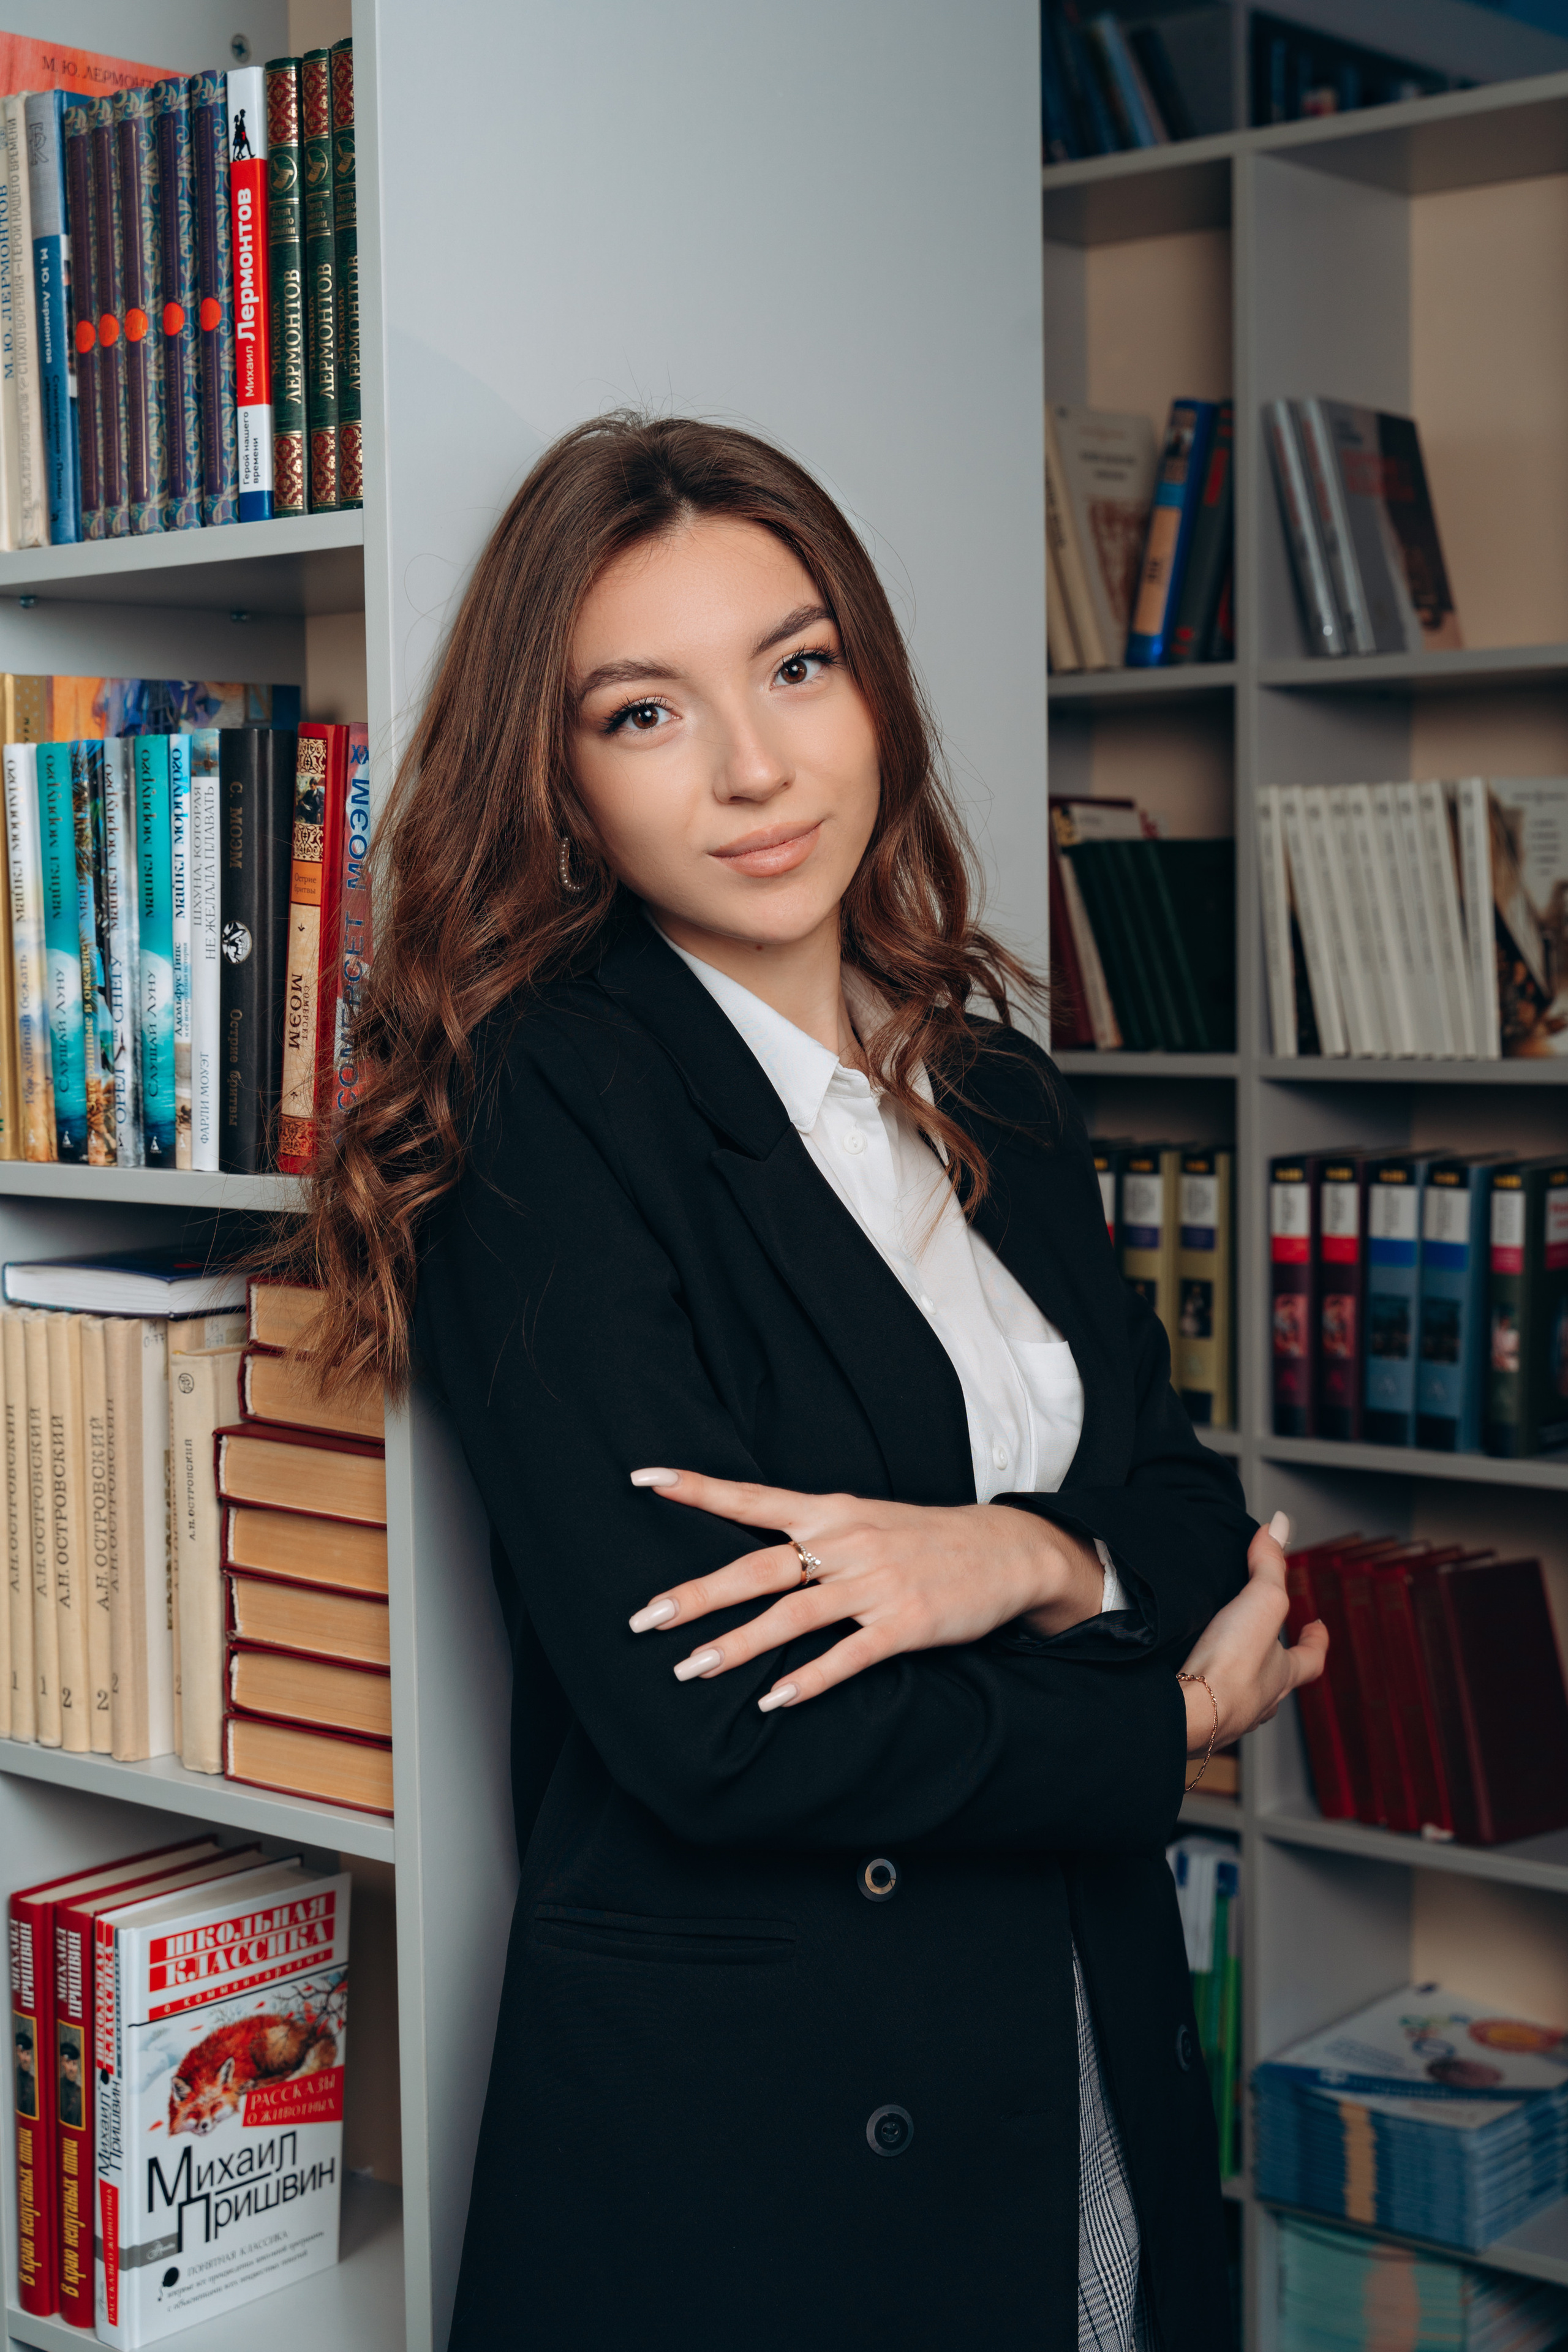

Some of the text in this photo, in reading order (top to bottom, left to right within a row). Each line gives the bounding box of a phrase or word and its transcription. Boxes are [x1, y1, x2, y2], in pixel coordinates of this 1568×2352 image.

[42, 56, 58, 72] М.
[62, 60, 80, 77] Ю.
[0, 185, 14, 380] М. Ю. ЛЕРМОНТОВ
[39, 247, 49, 265] М.
[40, 267, 50, 288] Ю.
[238, 187, 260, 397] Михаил Лермонтов
[42, 290, 53, 364] Лермонтов
[271, 301, 281, 377] Михаил
[284, 269, 302, 404] ЛЕРМОНТОВ
[317, 263, 334, 399] ЛЕРМОНТОВ
[337, 287, 346, 363] Михаил
[347, 255, 361, 390] ЛЕРМОНТОВ
[192, 786, 202, 926] ШХУНА, КОТОРАЯ
[228, 781, 243, 869] С. МОЭМ
[347, 778, 370, 891] МОЭМ
[205, 786, 216, 960] НЕ ЖЕЛАЛА ПЛАВАТЬ
[294, 872, 317, 886] Острие
[294, 883, 317, 895] бритвы
[18, 954, 29, 1009] бежать
[111, 954, 124, 1023] СНЕГУ
[173, 942, 182, 973] Типс
[81, 945, 98, 1112] Затерянные в океане
[288, 973, 303, 1050] МОЭМ
[200, 1052, 210, 1144] ФАРЛИ МОУЭТ
[227, 1008, 243, 1126] Острие бритвы
[51, 1414, 70, 1565] ОСТРОВСКИЙ
[89, 1415, 111, 1612] А.Н. ОСТРОВСКИЙ
[12, 1671, 20, 1691] 1
[40, 1676, 47, 1695] 1
[62, 1687, 72, 1708] 2
[97, 1690, 110, 1711] 2
[111, 1673, 119, 1694] 2
[165, 1896, 326, 1959] ШКОЛЬНАЯ
[165, 1922, 328, 1987] КЛАССИКА
[20, 1921, 34, 2010] ПРИШВИН
[67, 1929, 83, 2019] ПРИШВИН
[183, 1952, 325, 2007] комментариями
[109, 2081, 124, 2171] Пришвин
[251, 2074, 336, 2111] РАССКАЗЫ
[260, 2098, 335, 2124] ЖИВОТНЫХ
[97, 2091, 111, 2176] Михаил
[19, 2165, 41, 2237] непуганых
[148, 2130, 297, 2214] Михаил
[177, 2157, 336, 2253] Пришвин
[62, 2176, 86, 2248] непуганых
[239, 2228, 288, 2257] КЛАССИКА
[19, 2270, 36, 2287] В
[20, 2236, 42, 2274] краю
[61, 2282, 79, 2299] В
[62, 2248, 87, 2285] краю
